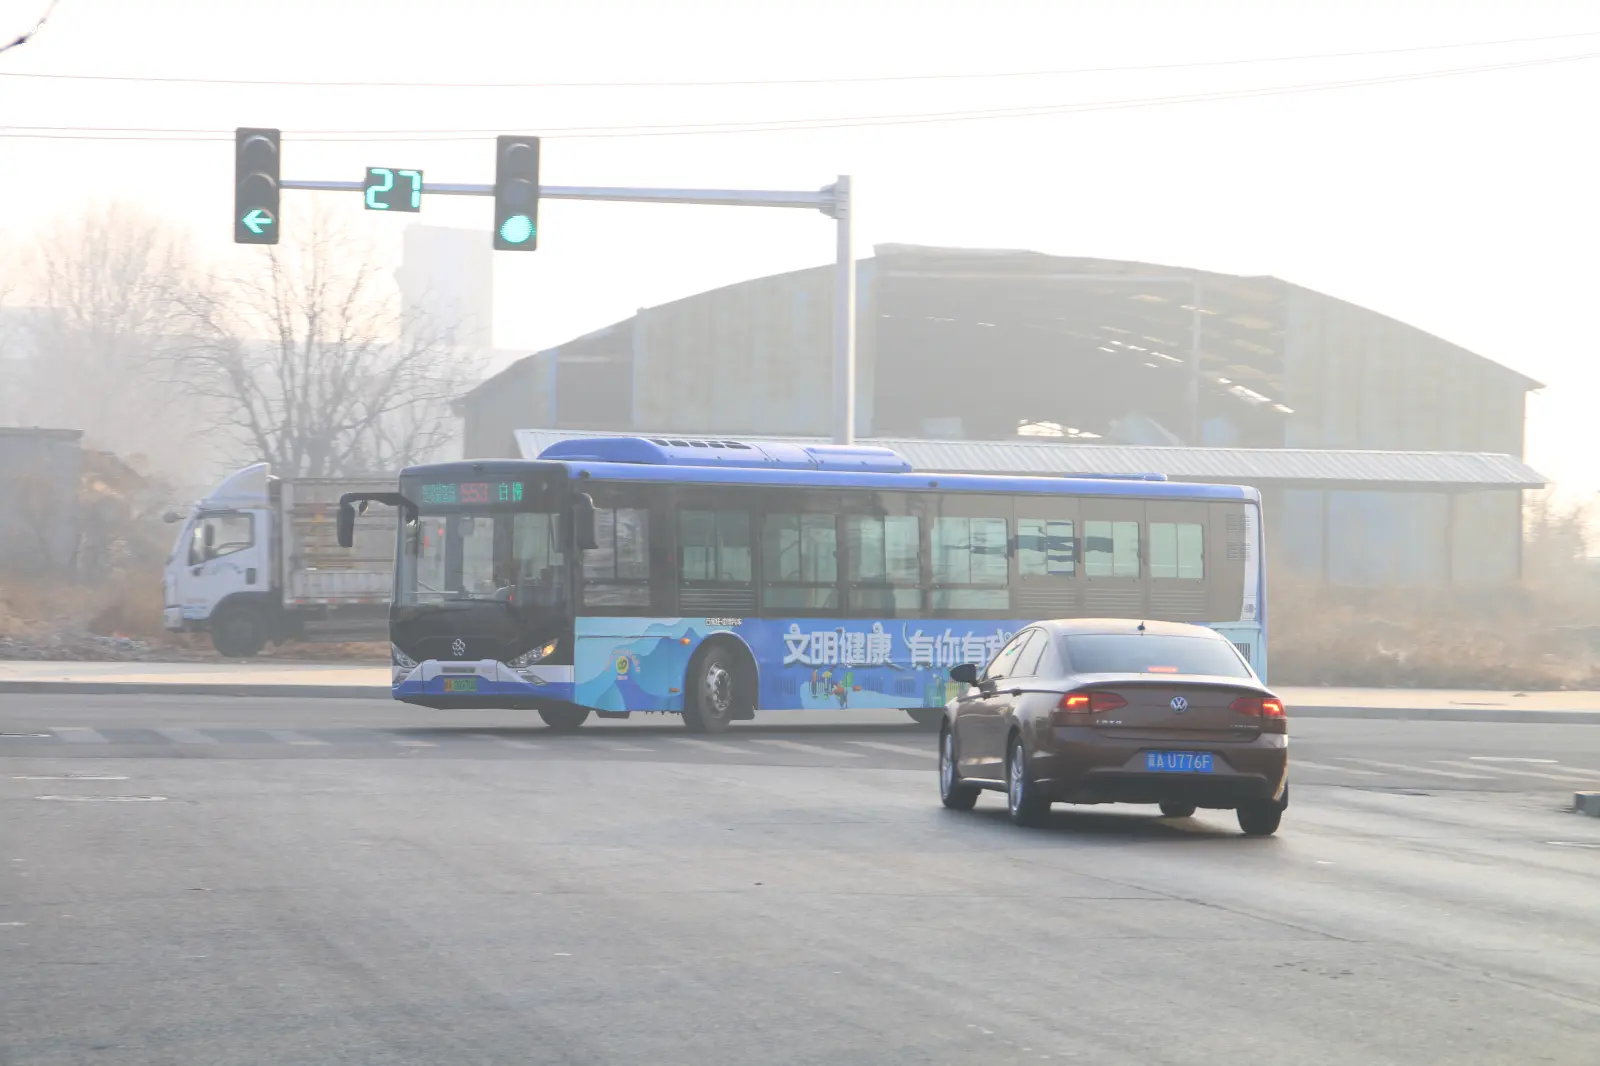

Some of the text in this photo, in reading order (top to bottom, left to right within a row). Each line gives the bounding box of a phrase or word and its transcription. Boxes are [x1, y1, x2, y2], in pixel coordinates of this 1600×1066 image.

[366, 168, 421, 209] 27
[783, 622, 893, 667] 文明健康
